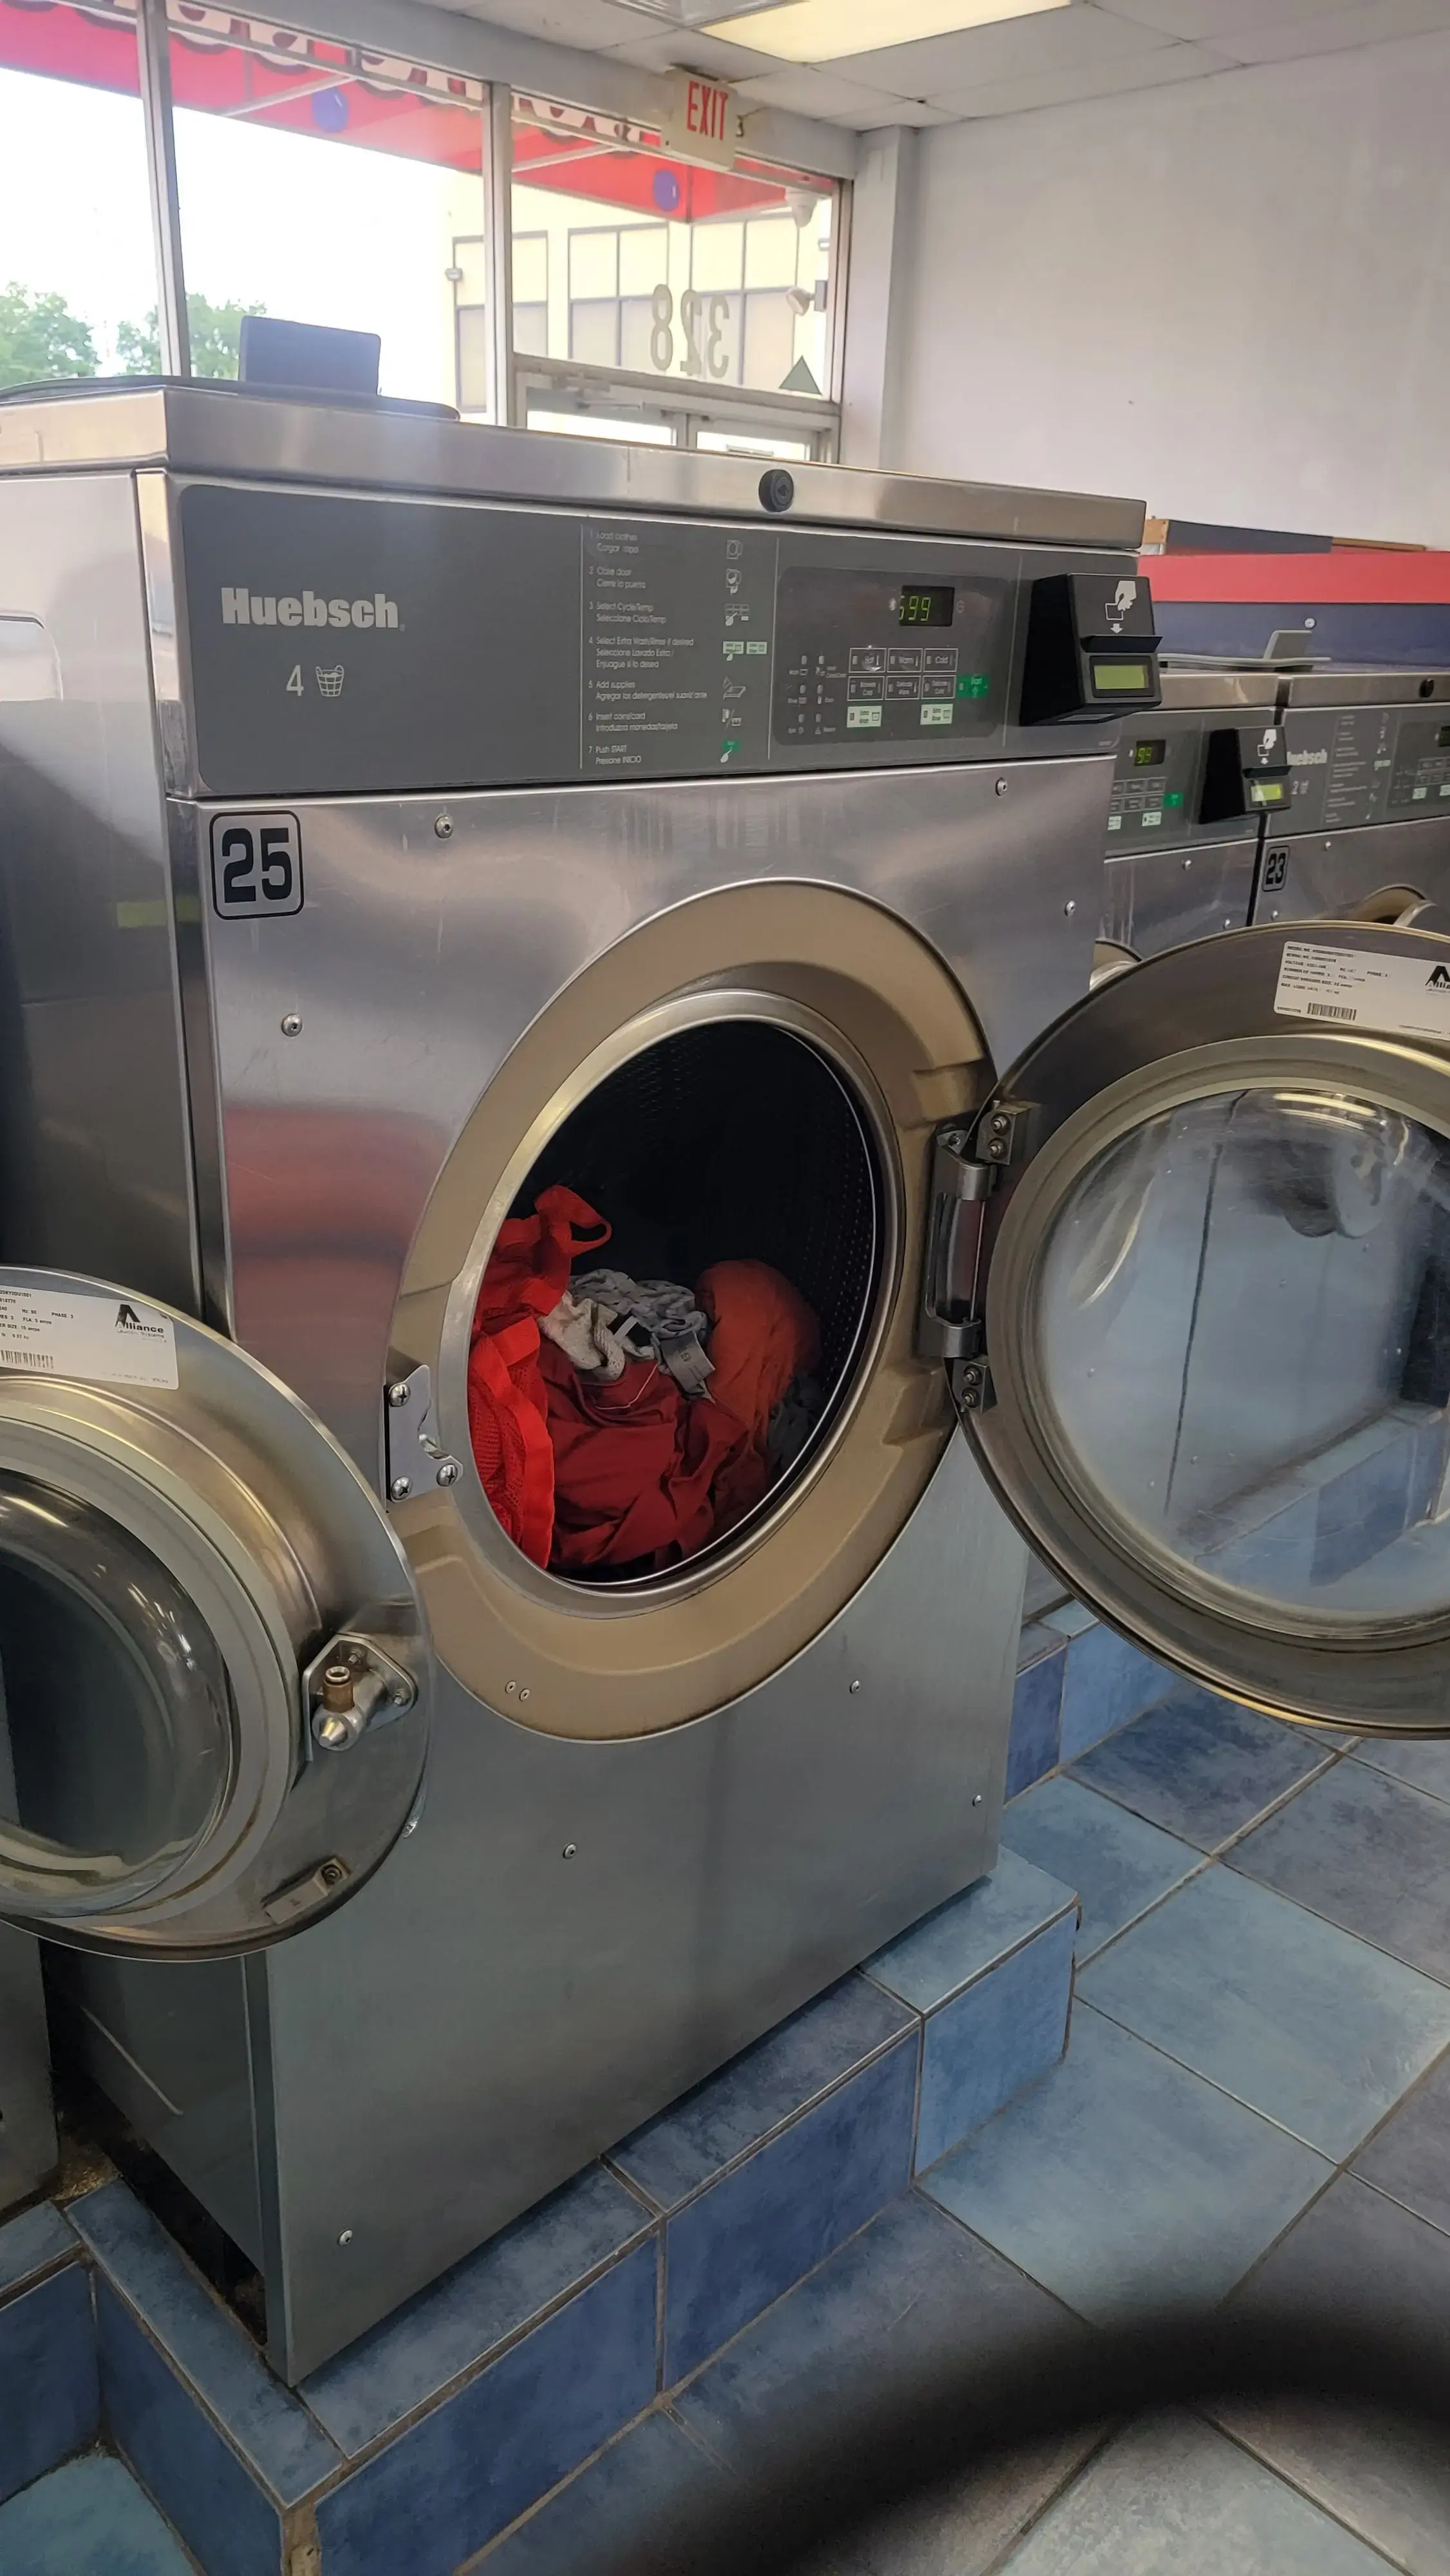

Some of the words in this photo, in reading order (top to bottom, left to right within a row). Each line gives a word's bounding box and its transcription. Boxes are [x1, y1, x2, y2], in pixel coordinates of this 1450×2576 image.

[686, 80, 729, 141] EXIT
[589, 566, 594, 574] 2
[596, 566, 615, 576] Close
[221, 587, 399, 629] Huebsch
[588, 601, 594, 610] 3
[596, 601, 616, 610] Select
[596, 614, 632, 623] Seleccione
[596, 636, 616, 645] Select
[617, 637, 632, 645] Extra
[596, 648, 631, 656] Seleccione
[632, 649, 655, 657] Lavado
[596, 660, 625, 669] Enjuague
[935, 656, 948, 664] Cold
[286, 665, 304, 696] 4
[596, 692, 621, 701] Agregar
[622, 755, 641, 764] INICIO
[1291, 781, 1299, 795] 2
[222, 828, 292, 903] 25
[1266, 853, 1286, 885] 23
